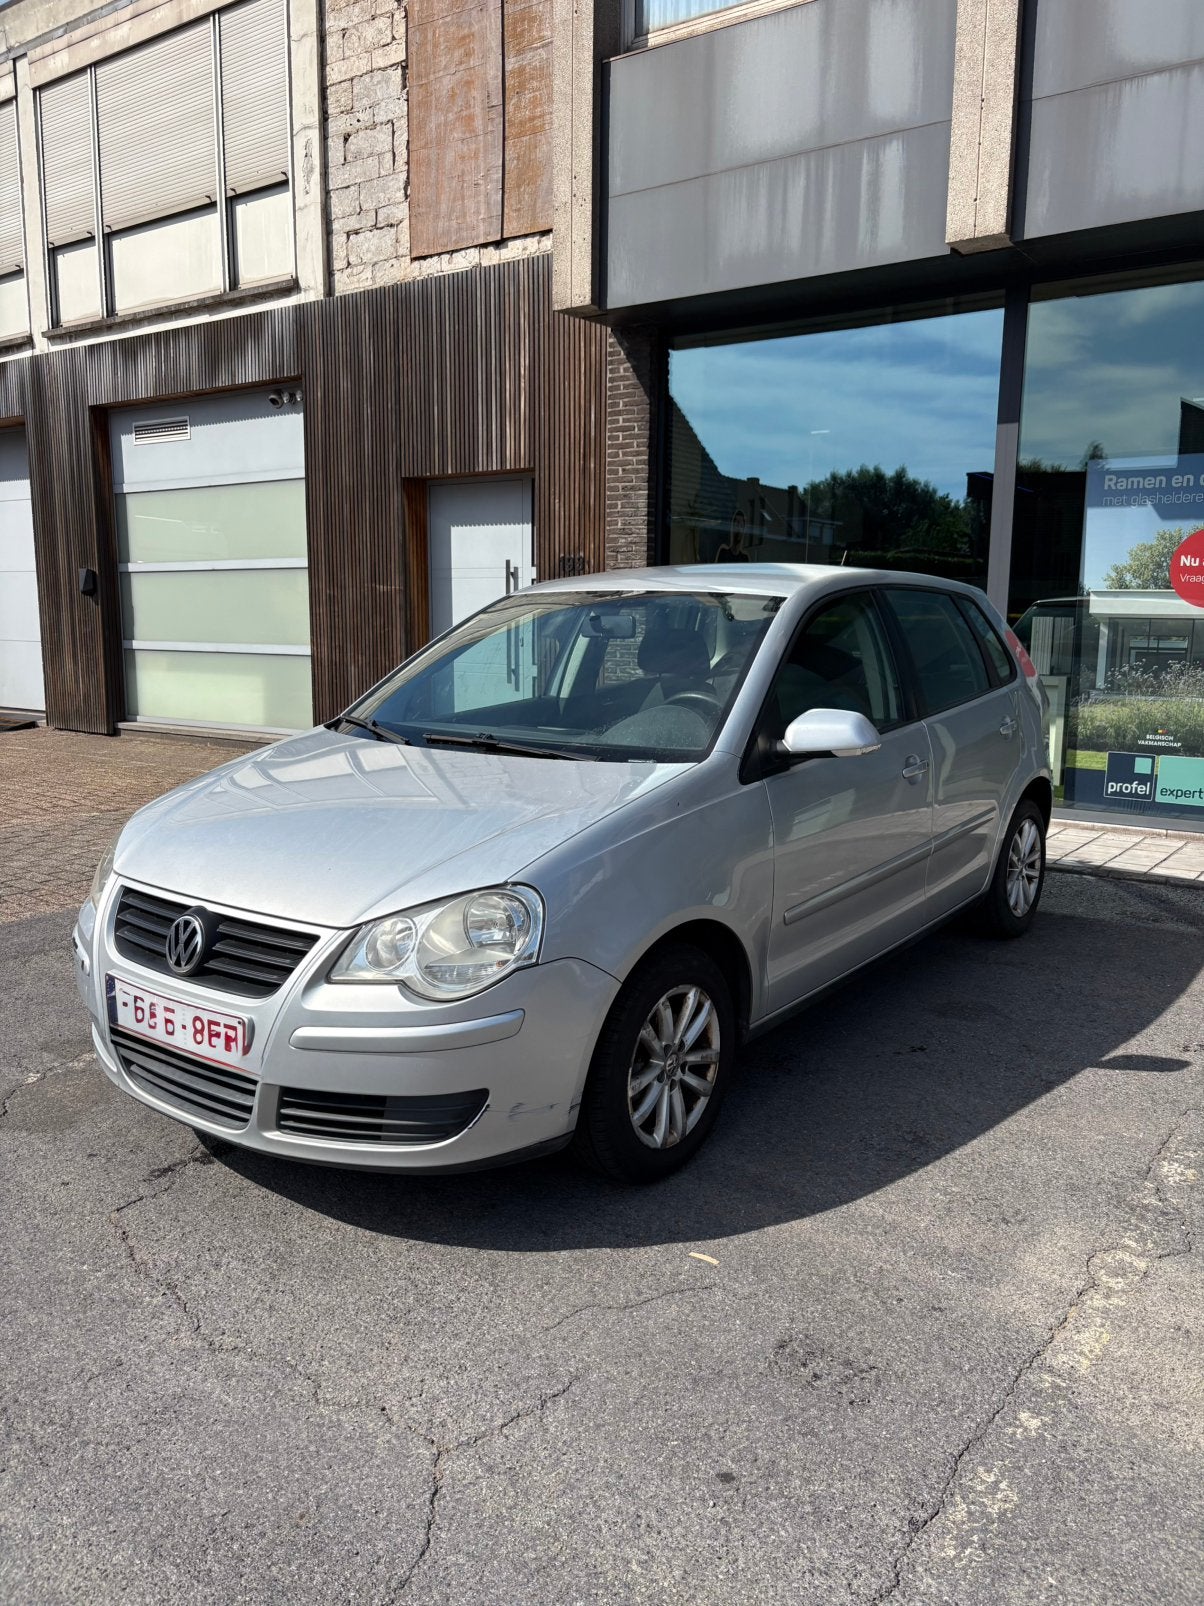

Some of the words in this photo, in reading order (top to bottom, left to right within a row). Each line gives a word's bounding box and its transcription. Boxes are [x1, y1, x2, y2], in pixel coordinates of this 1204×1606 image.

[1104, 474, 1167, 490] Ramen
[1171, 474, 1194, 488] en
[1102, 494, 1128, 506] met
[1130, 491, 1204, 508] glasheldere
[1180, 554, 1200, 567] Nu
[1137, 740, 1182, 748] VAKMANSCHAP
[1107, 781, 1151, 795] profel
[1159, 786, 1204, 800] expert
